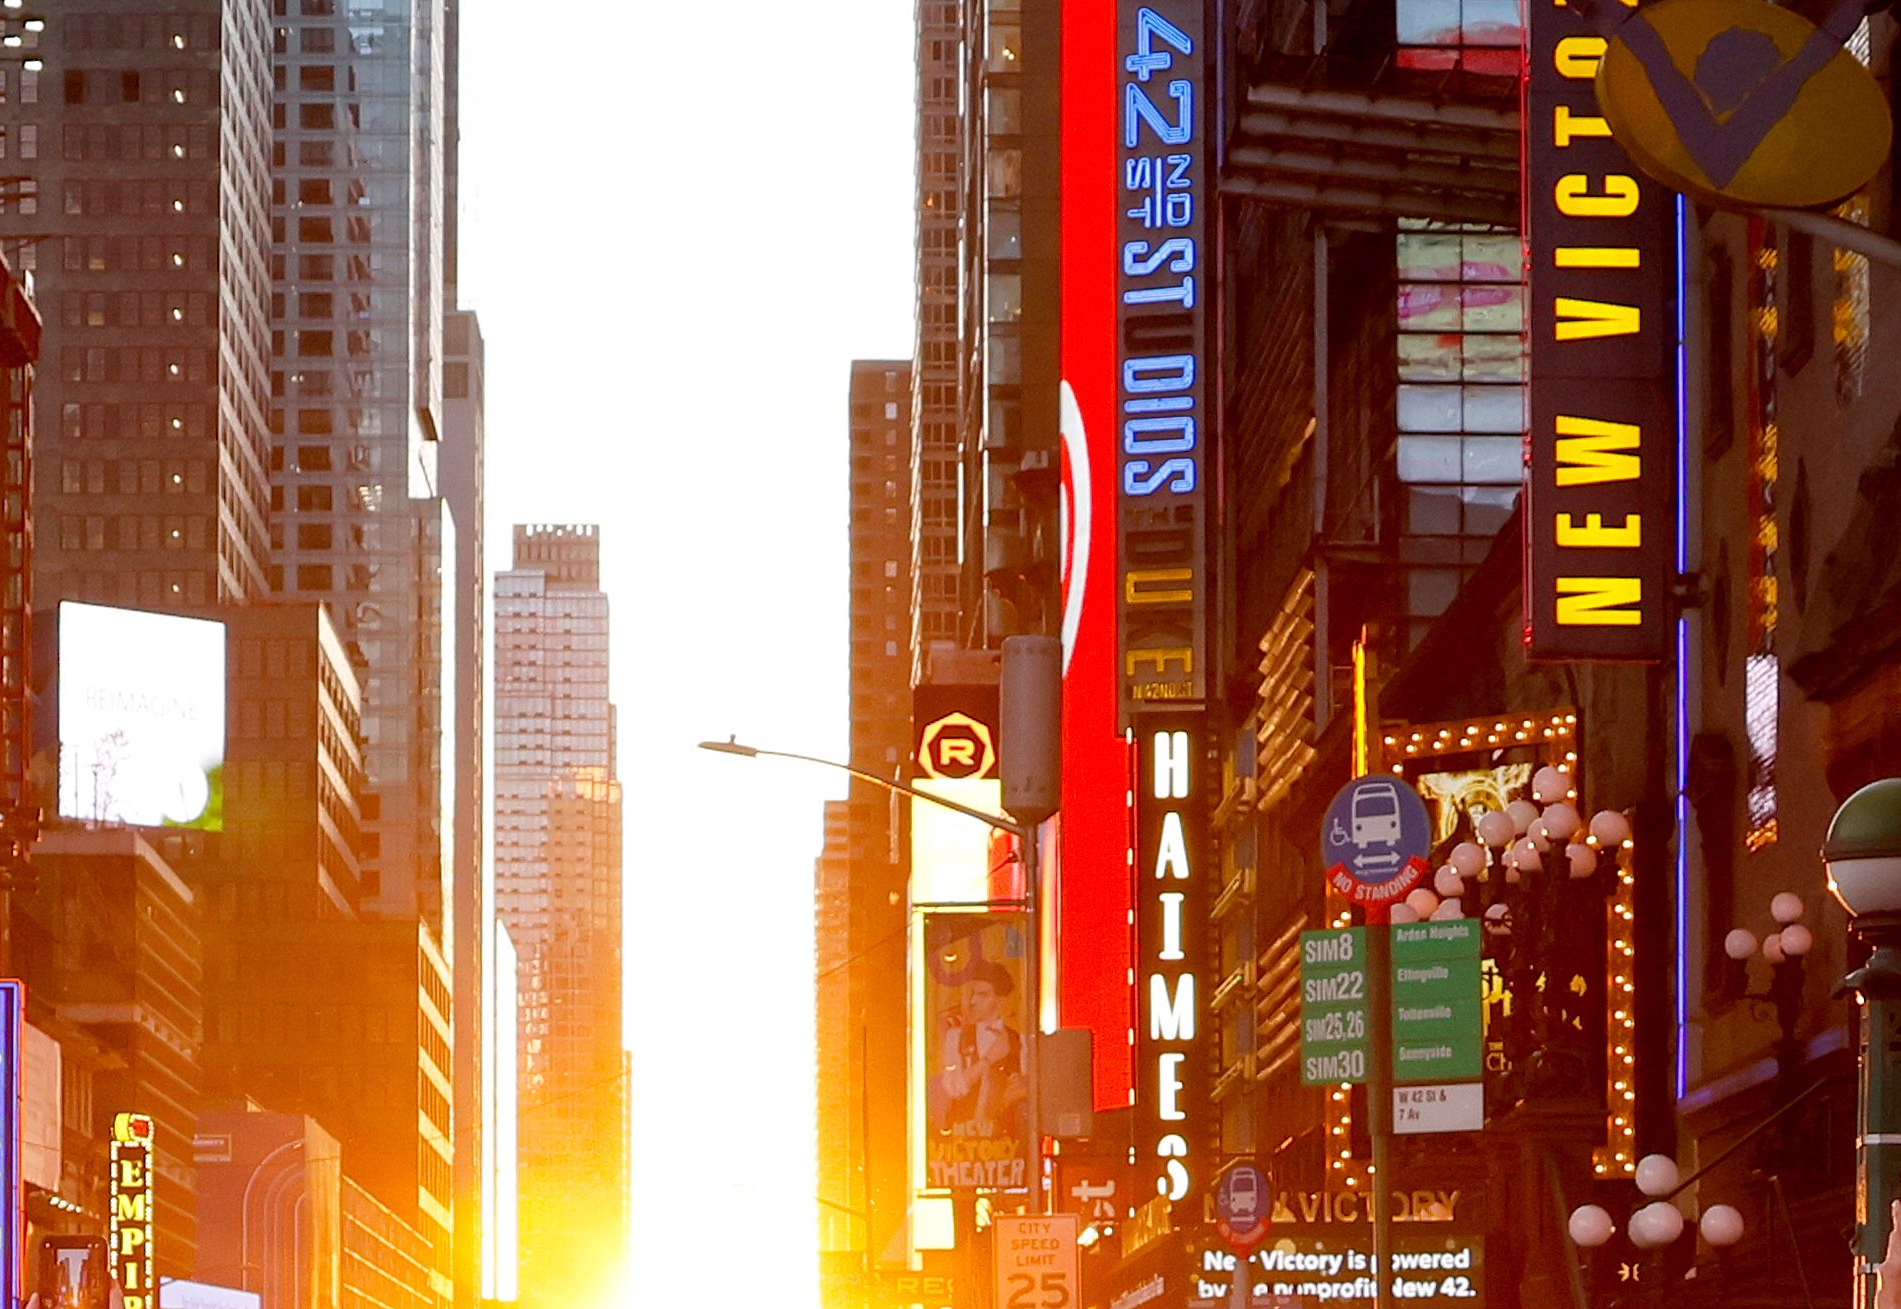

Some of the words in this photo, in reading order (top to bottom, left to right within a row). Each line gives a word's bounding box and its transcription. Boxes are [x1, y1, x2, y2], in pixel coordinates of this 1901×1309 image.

[1125, 8, 1193, 148] 42
[1166, 154, 1192, 228] ND
[1123, 238, 1195, 497] STUDIOS
[1555, 415, 1641, 625] NEW
[940, 738, 975, 765] R
[1333, 872, 1353, 893] NO
[1355, 864, 1418, 900] STANDING
[1305, 933, 1354, 964] SIM8
[1150, 731, 1193, 1202] HAIMES
[1305, 971, 1364, 1003] SIM22
[1306, 1010, 1364, 1042] SIM25,26
[1306, 1050, 1365, 1081] SIM30
[929, 1158, 1026, 1187] THEATER
[1011, 1238, 1060, 1251] SPEED
[1018, 1222, 1052, 1235] CITY
[1016, 1254, 1056, 1267] LIMIT
[1260, 1249, 1342, 1276] Victory
[1348, 1250, 1366, 1270] is
[1006, 1272, 1070, 1309] 25
